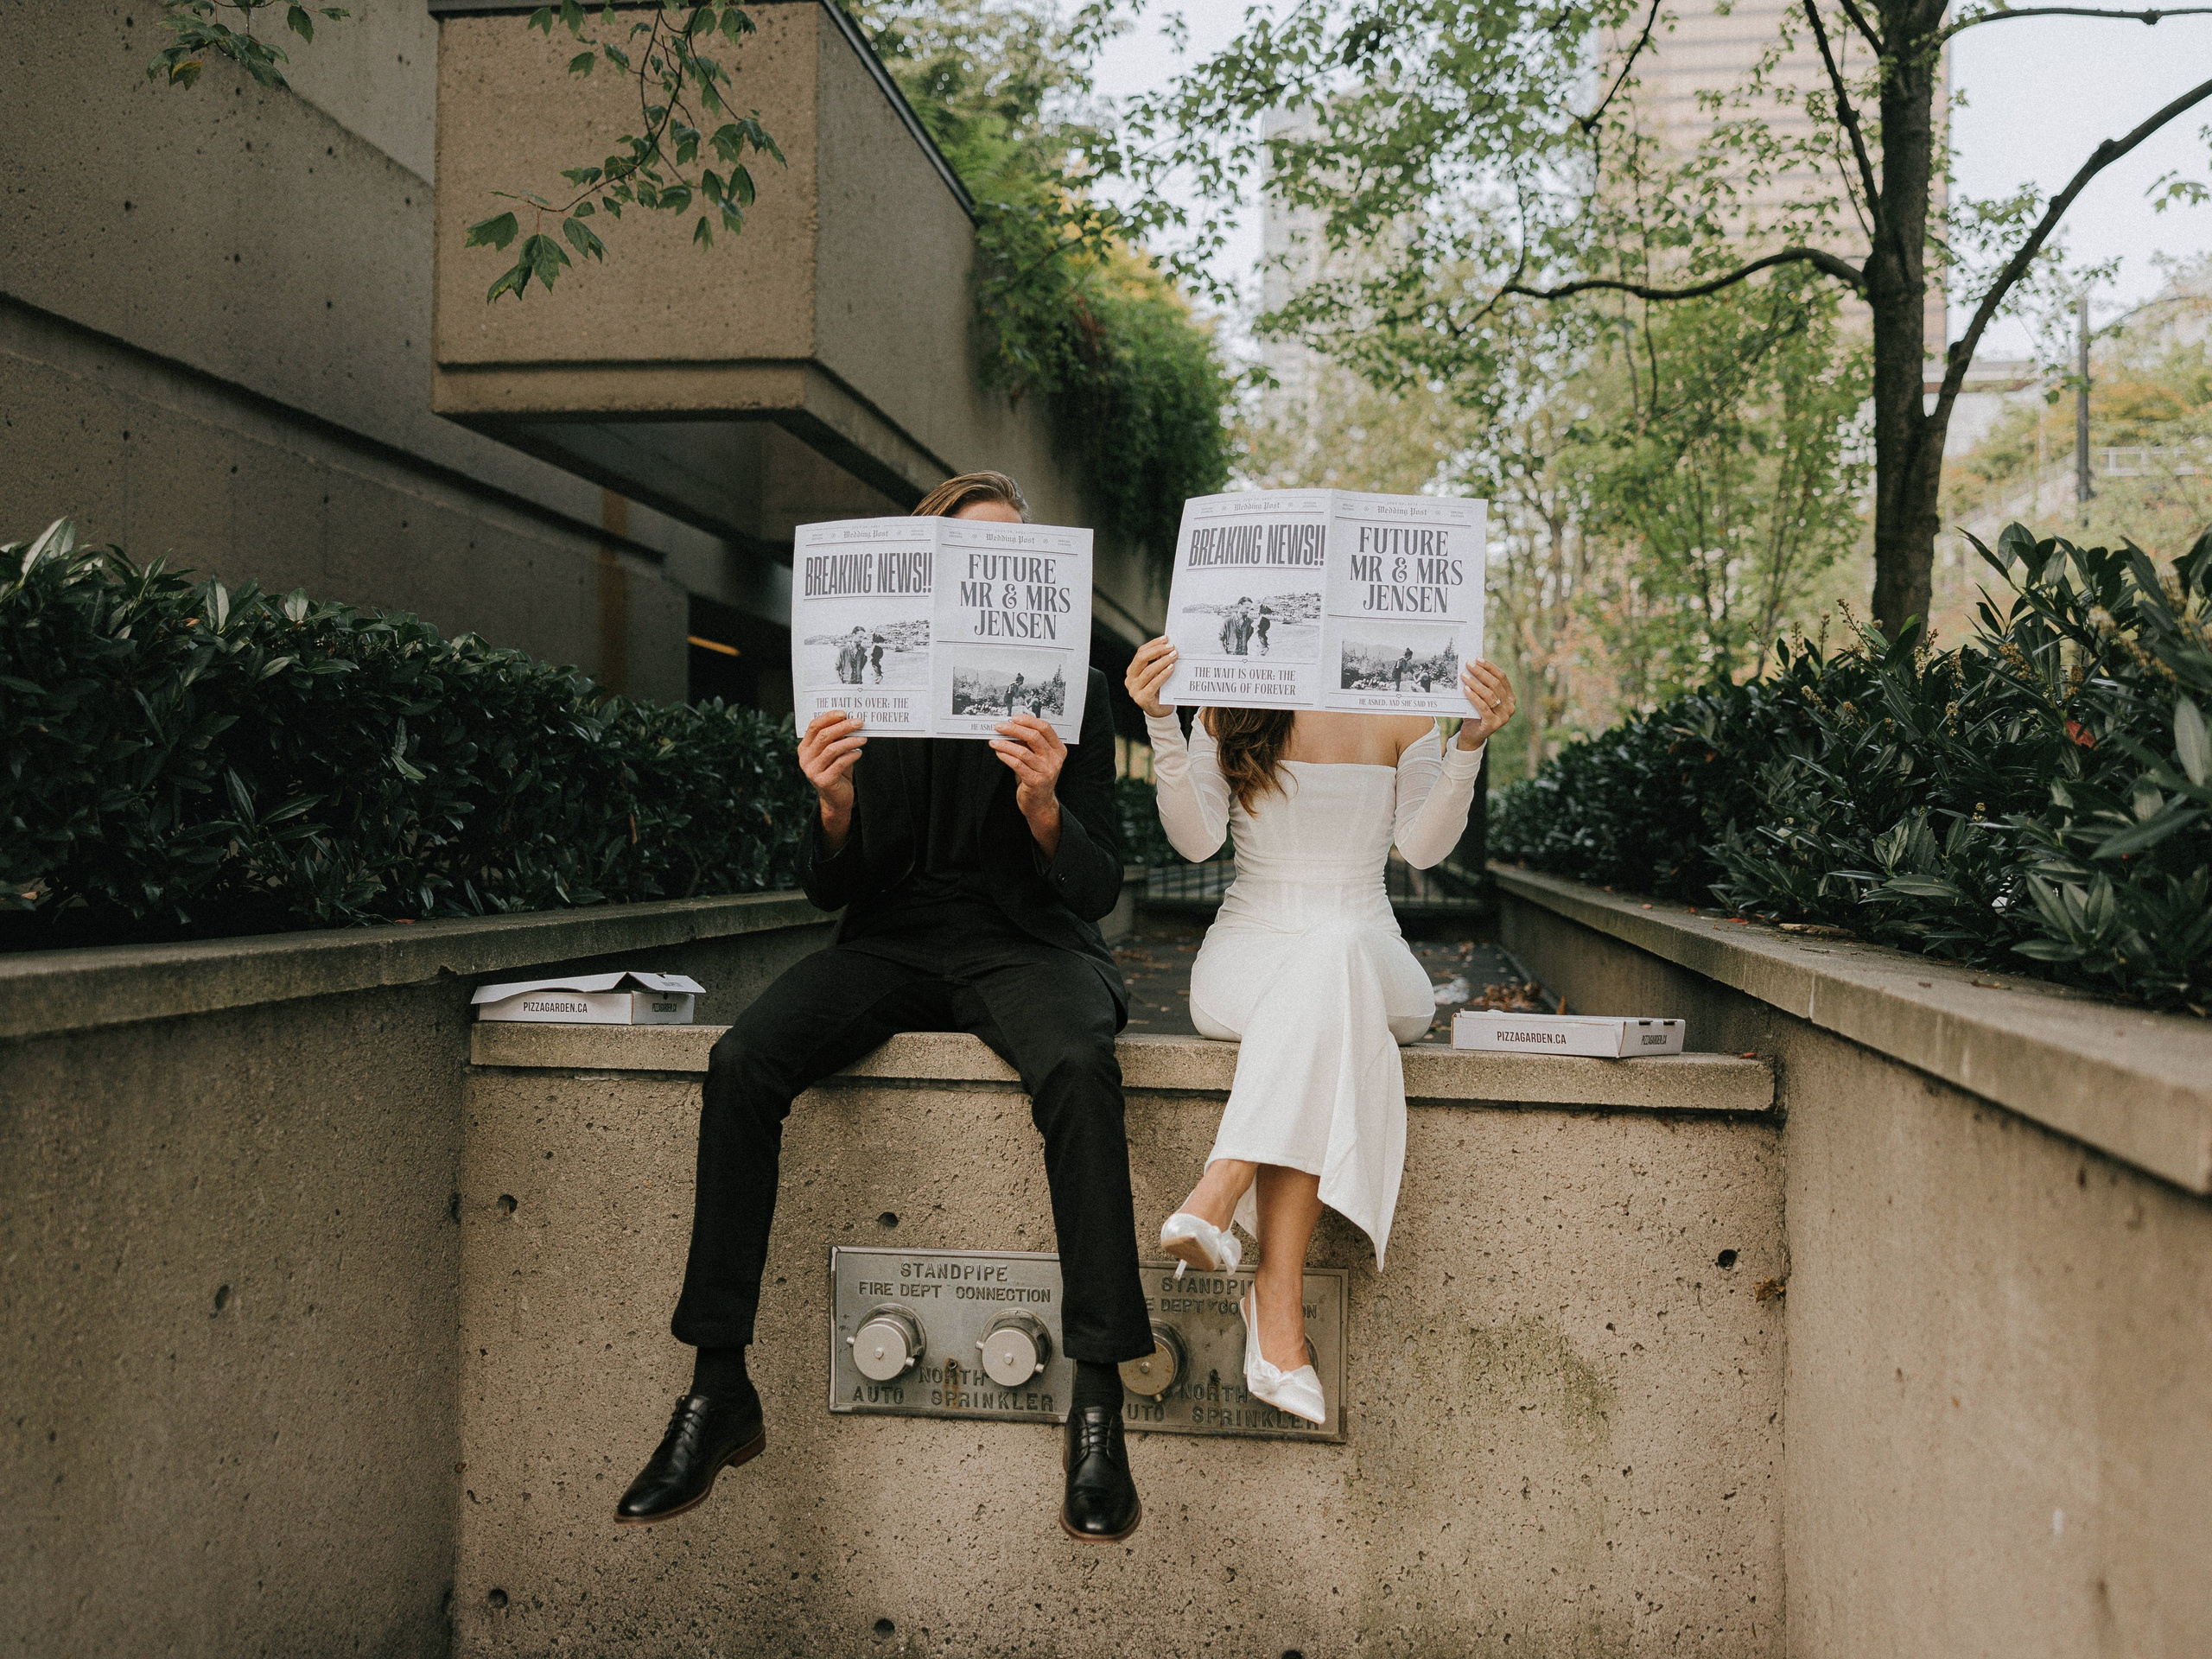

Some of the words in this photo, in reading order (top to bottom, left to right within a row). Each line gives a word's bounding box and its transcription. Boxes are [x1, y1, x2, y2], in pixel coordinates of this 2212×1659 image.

[1264, 501, 1280, 510] Post
[1377, 505, 1408, 516] Wedding
[1410, 507, 1427, 517] Post
[843, 531, 871, 539] Wedding
[986, 533, 1016, 543] Wedding
[1018, 535, 1035, 544] Post
[1359, 526, 1448, 556] FUTURE
[1188, 524, 1262, 566] BREAKING
[1266, 524, 1326, 566] NEWS!!
[805, 553, 873, 596] BREAKING
[877, 552, 932, 593] NEWS!!
[969, 554, 1056, 584] FUTURE
[1350, 554, 1382, 582] MR
[1391, 556, 1408, 583] &
[1416, 557, 1464, 586] MRS
[960, 581, 993, 608] MR
[1001, 583, 1017, 609] &
[1026, 584, 1071, 613] MRS
[1363, 584, 1448, 613] JENSEN
[974, 610, 1056, 640] JENSEN
[1194, 666, 1211, 678] THE
[1214, 667, 1236, 679] WAIT
[1238, 668, 1247, 679] IS
[1249, 669, 1275, 681] OVER:
[1278, 670, 1295, 681] THE
[1189, 681, 1236, 693] BEGINNING
[1240, 683, 1252, 694] OF
[1255, 683, 1295, 696] FOREVER
[816, 697, 829, 709] THE
[831, 697, 851, 708] WAIT
[854, 697, 862, 709] IS
[865, 697, 890, 709] OVER:
[893, 697, 909, 709] THE
[1368, 698, 1388, 707] ASKED,
[871, 711, 909, 722] FOREVER
[523, 1001, 588, 1014] PIZZAGARDEN.CA
[1497, 1031, 1567, 1044] PIZZAGARDEN.CA
[900, 1262, 1008, 1281] STANDPIPE
[859, 1281, 893, 1296] FIRE
[899, 1283, 942, 1298] DEPT
[955, 1285, 1052, 1303] CONNECTION
[1161, 1276, 1254, 1295] STANDPI
[1160, 1298, 1204, 1313] DEPT
[918, 1366, 986, 1386] NORTH
[852, 1386, 905, 1404] AUTO
[931, 1390, 1054, 1412] SPRINKLER
[1180, 1382, 1248, 1402] NORTH
[1126, 1403, 1165, 1421] UTO
